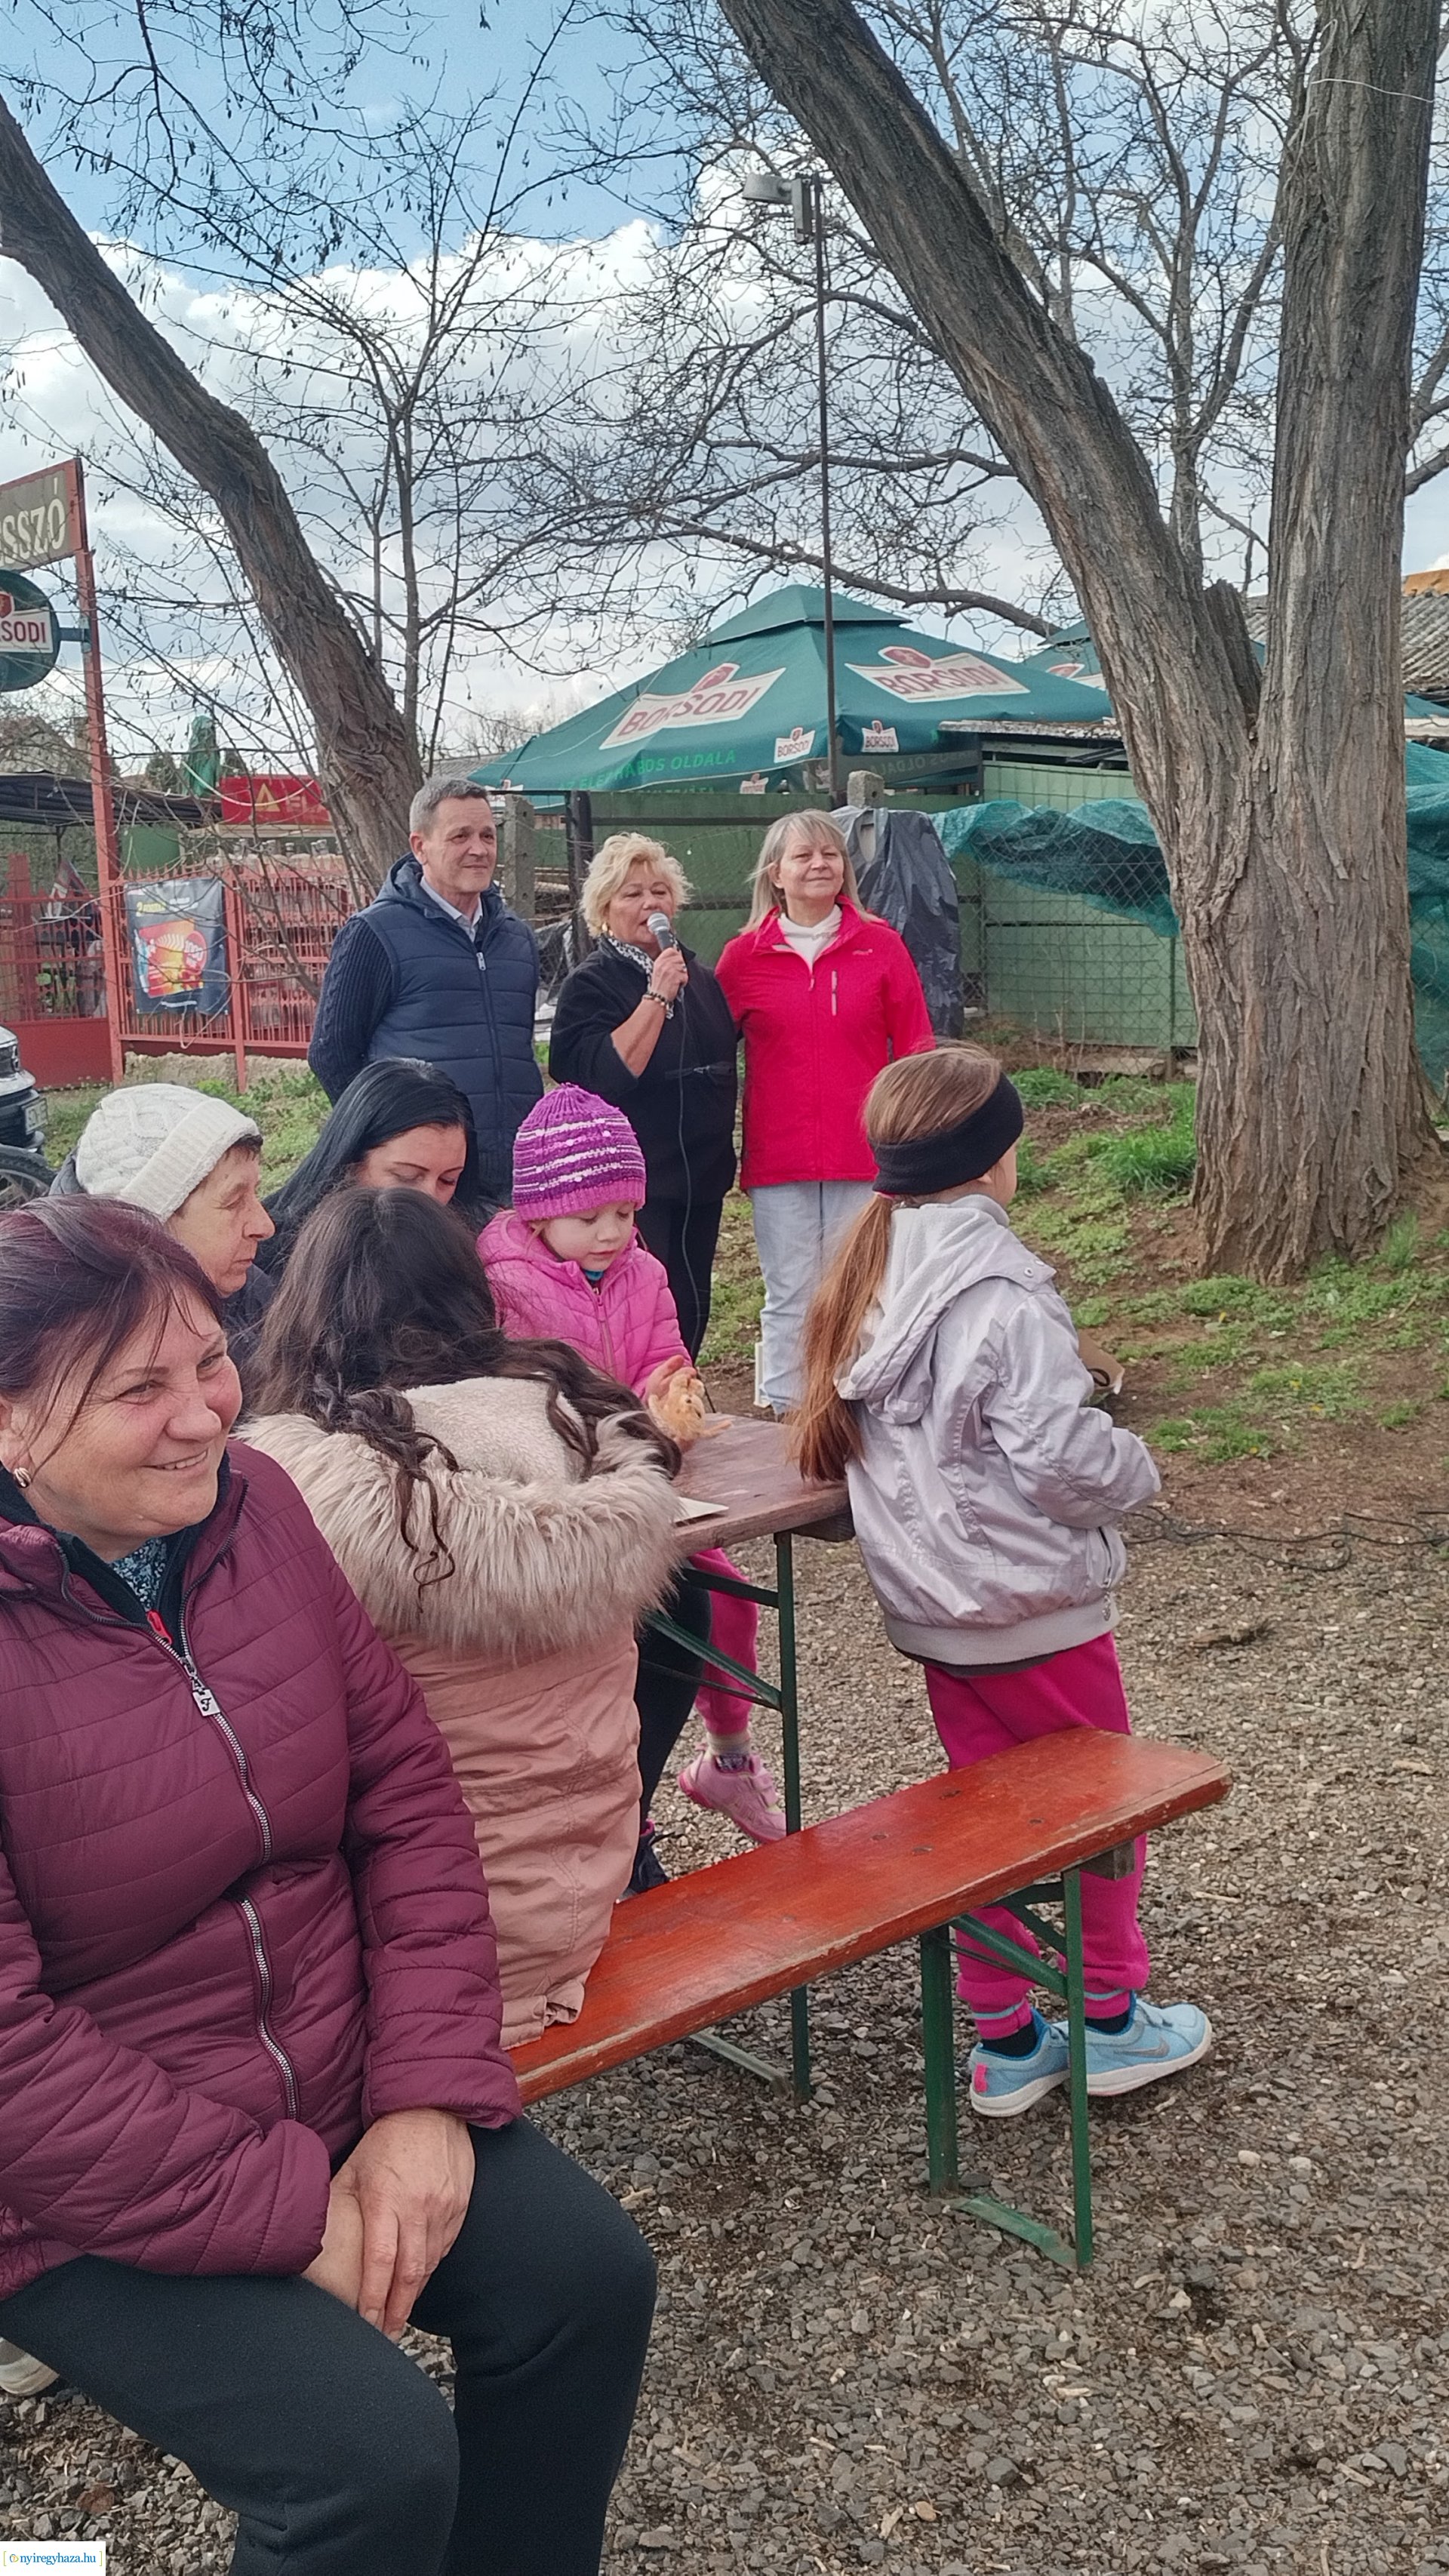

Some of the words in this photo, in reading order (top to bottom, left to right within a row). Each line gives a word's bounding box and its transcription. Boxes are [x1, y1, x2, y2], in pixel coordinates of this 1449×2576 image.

[0, 477, 66, 567] SSZÓ
[0, 620, 46, 642] SODI
[874, 665, 1002, 694] BORSODI
[617, 686, 762, 737] BORSODI
[777, 740, 810, 758] BORSODI
[865, 735, 895, 749] BORSODI
[670, 749, 736, 768] OLDALA
